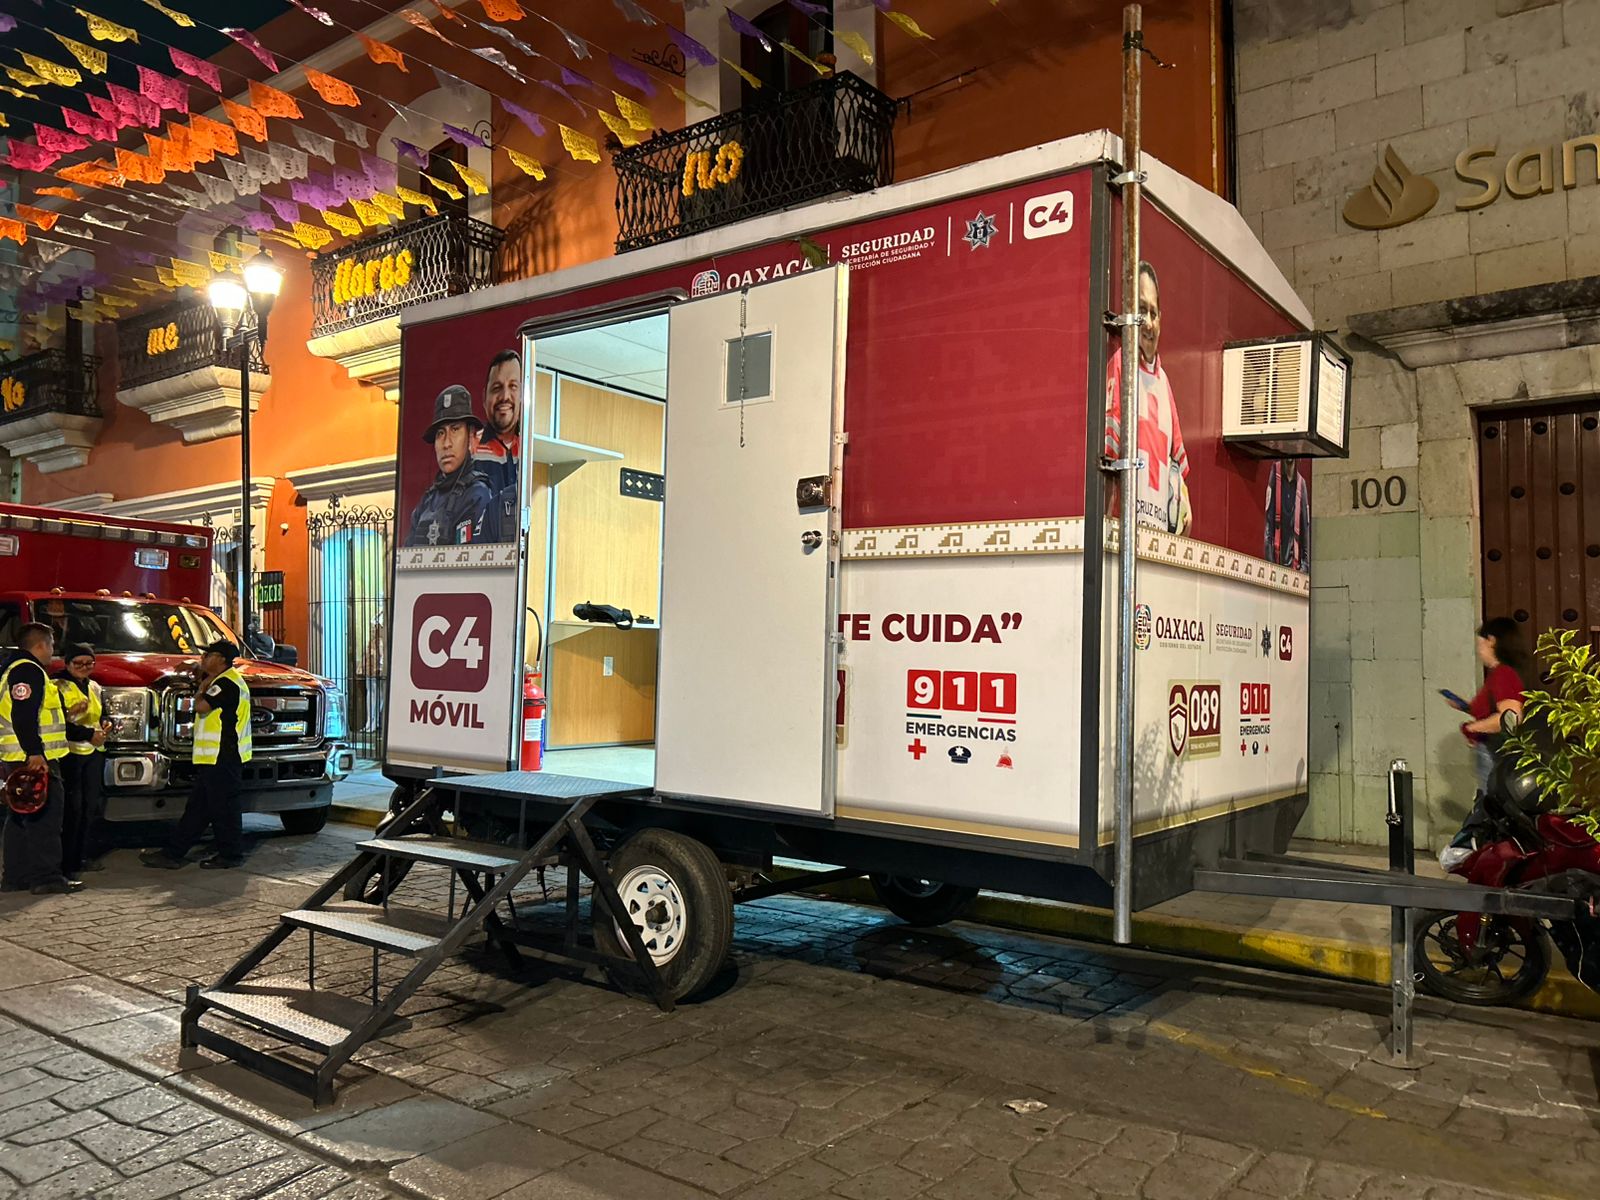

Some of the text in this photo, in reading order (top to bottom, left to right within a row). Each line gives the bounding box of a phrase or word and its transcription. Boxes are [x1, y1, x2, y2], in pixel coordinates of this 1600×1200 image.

[682, 140, 744, 197] no
[1028, 201, 1069, 229] C4
[841, 226, 936, 258] SEGURIDAD
[880, 249, 890, 258] DE
[891, 243, 929, 256] SEGURIDAD
[882, 251, 921, 265] CIUDADANA
[1351, 475, 1407, 509] 100
[417, 615, 484, 669] C4
[1155, 616, 1205, 642] OAXACA
[1215, 623, 1253, 640] SEGURIDAD
[1280, 633, 1292, 654] C4
[912, 674, 1006, 709] 911
[1241, 687, 1269, 712] 911
[409, 693, 485, 729] MÓVIL
[1190, 689, 1219, 732] 089
[905, 721, 1017, 743] EMERGENCIAS
[1240, 724, 1271, 736] EMERGENCIAS
